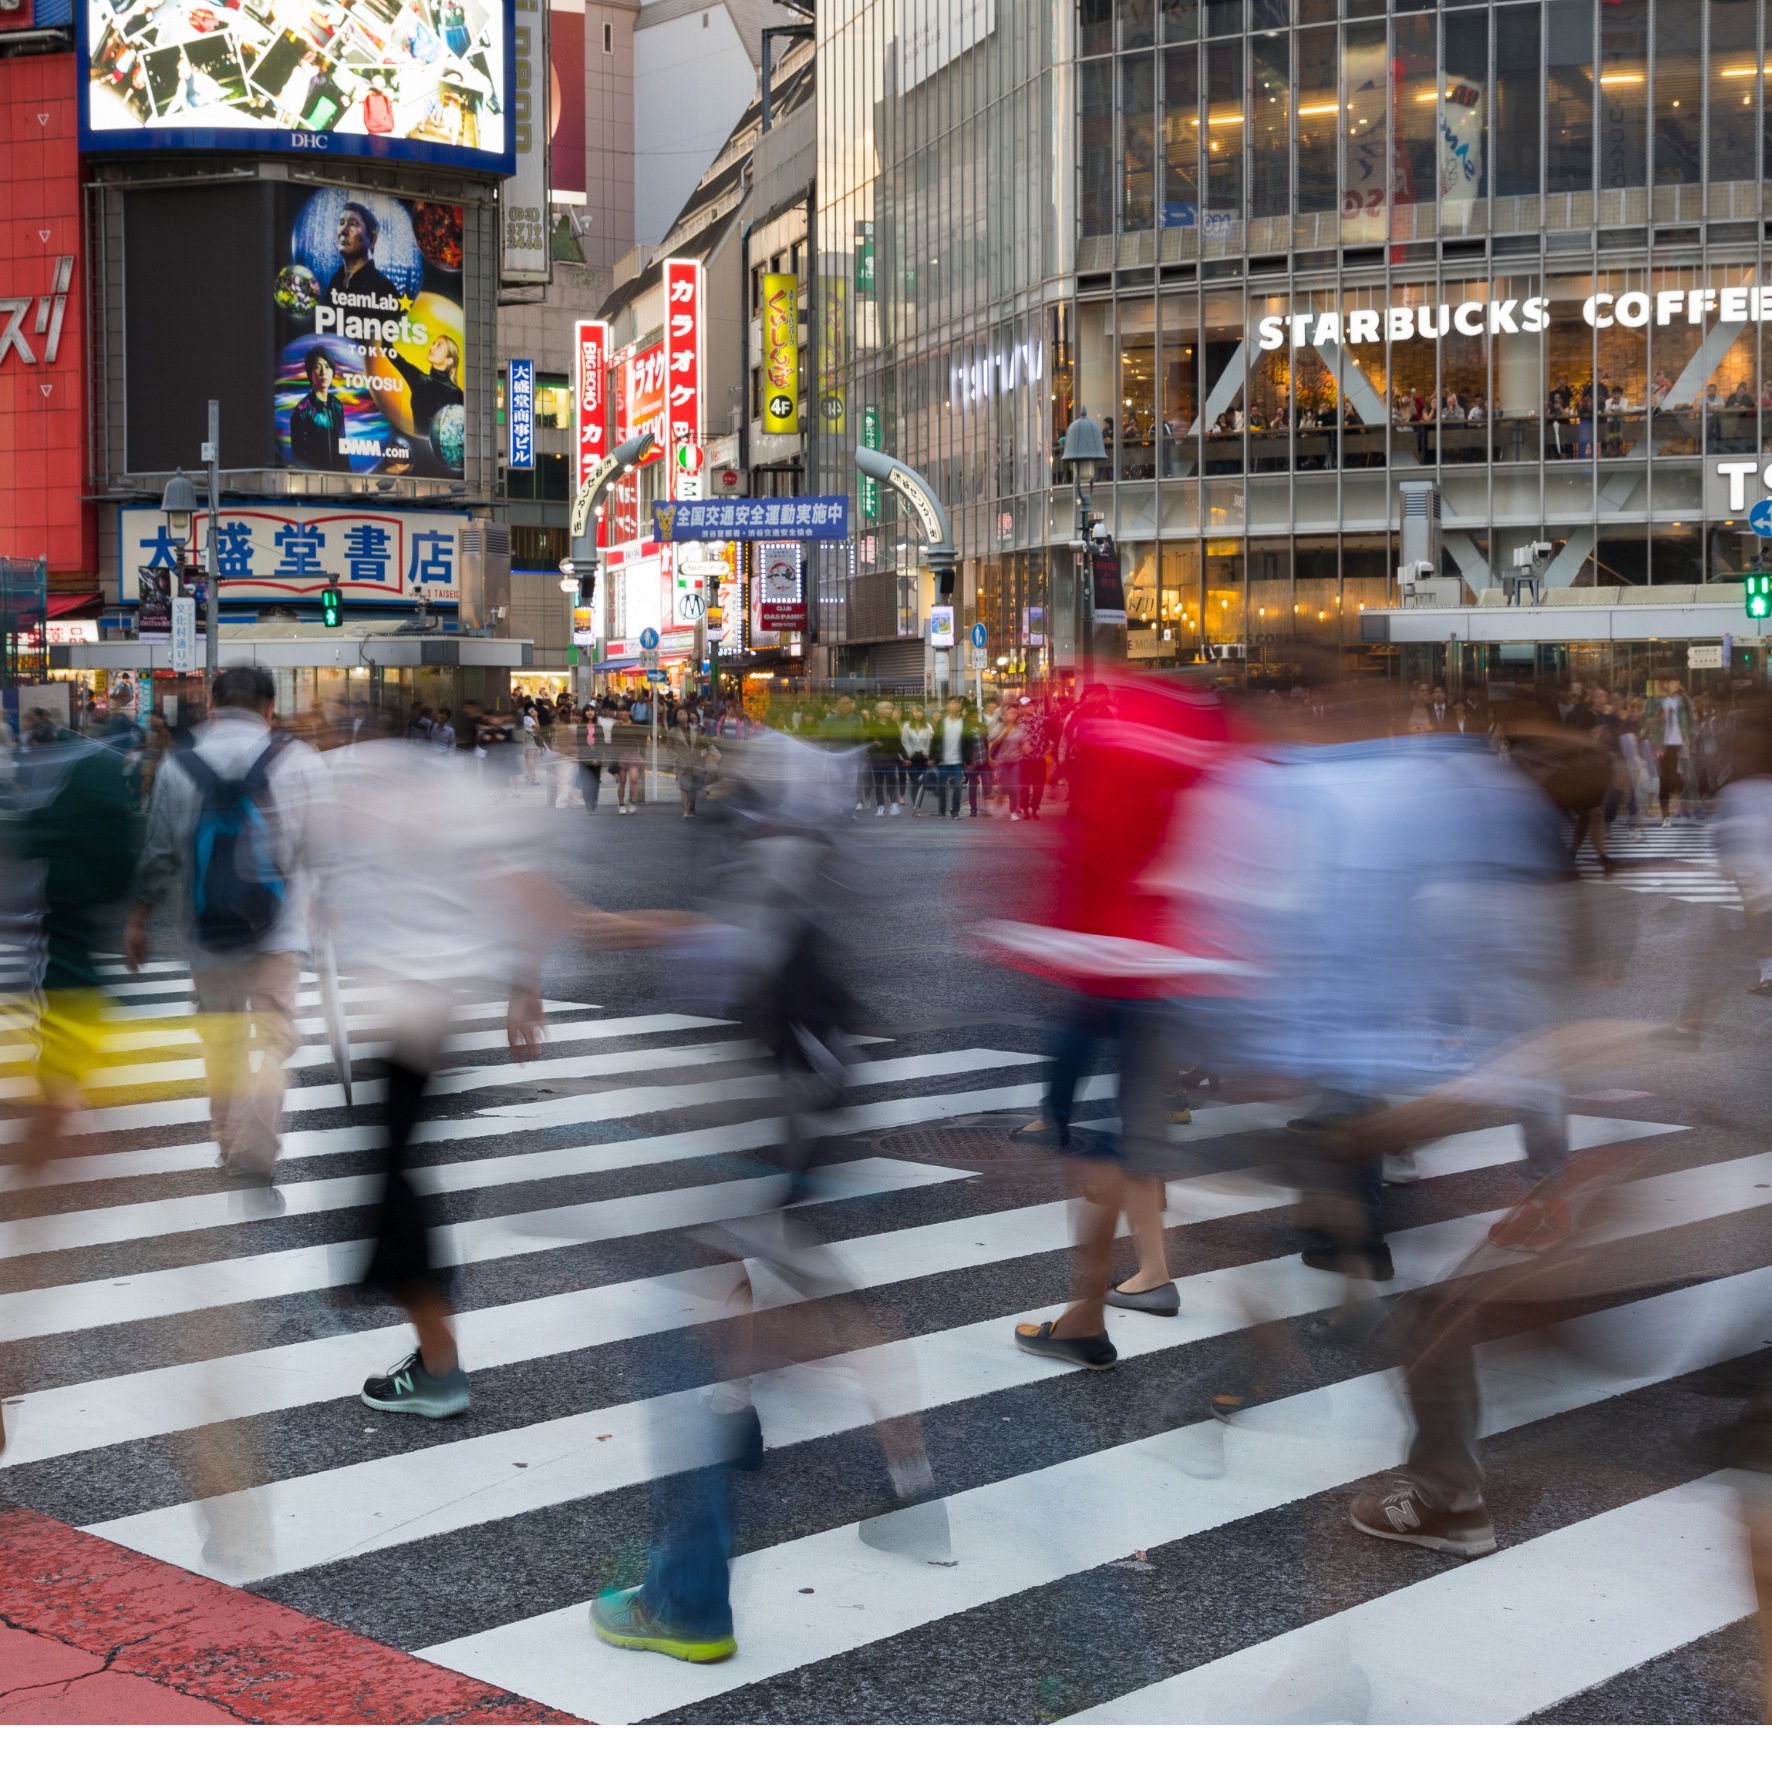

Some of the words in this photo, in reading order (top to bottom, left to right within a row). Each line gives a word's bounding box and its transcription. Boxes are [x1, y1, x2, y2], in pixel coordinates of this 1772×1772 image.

[291, 133, 328, 149] DHC
[508, 206, 541, 223] (03)
[506, 222, 542, 237] 3719
[506, 235, 544, 250] 2468
[331, 288, 399, 312] teamLab
[315, 304, 429, 346] Planets
[1258, 297, 1550, 351] STARBUCKS
[1583, 287, 1772, 329] COFFEE
[347, 343, 399, 360] TOKYO
[669, 279, 695, 407] カラオケ
[768, 289, 792, 389] くいしんぼ
[582, 341, 597, 370] BIG
[342, 372, 404, 393] TOYOSU
[583, 370, 597, 411] ECHO
[513, 365, 531, 463] 大盛堂商事ビル
[770, 398, 791, 416] 4F
[338, 437, 410, 459] DMM.com
[1717, 462, 1772, 511] T
[676, 502, 843, 527] 全国交通安全運動実施中
[139, 521, 455, 584] 大盛堂書店
[763, 613, 780, 621] GAS
[393, 1370, 415, 1395] N
[1385, 1499, 1421, 1533] N
